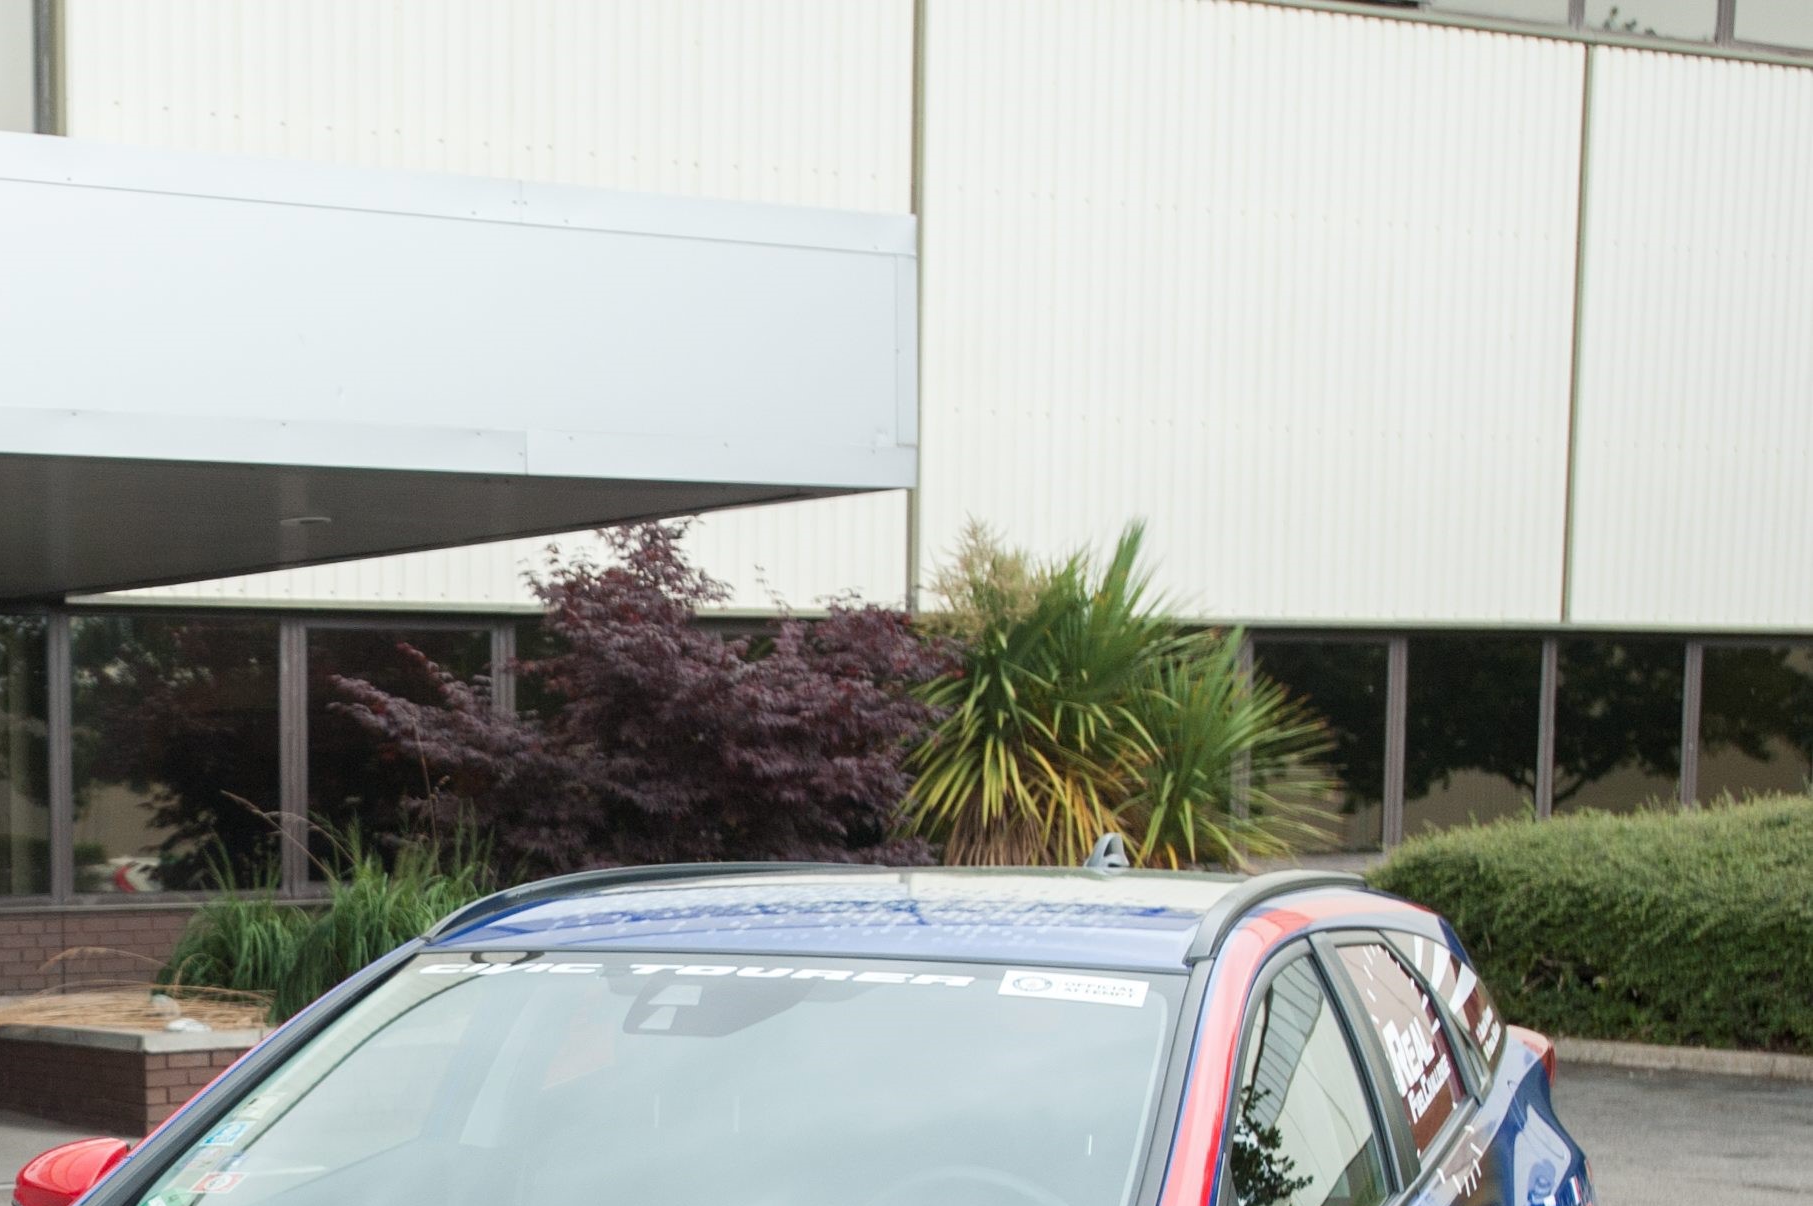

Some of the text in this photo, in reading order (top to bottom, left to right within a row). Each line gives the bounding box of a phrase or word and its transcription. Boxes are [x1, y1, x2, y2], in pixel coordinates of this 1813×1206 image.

[419, 963, 975, 987] CIVIC TOURER
[1383, 1019, 1436, 1097] REAL
